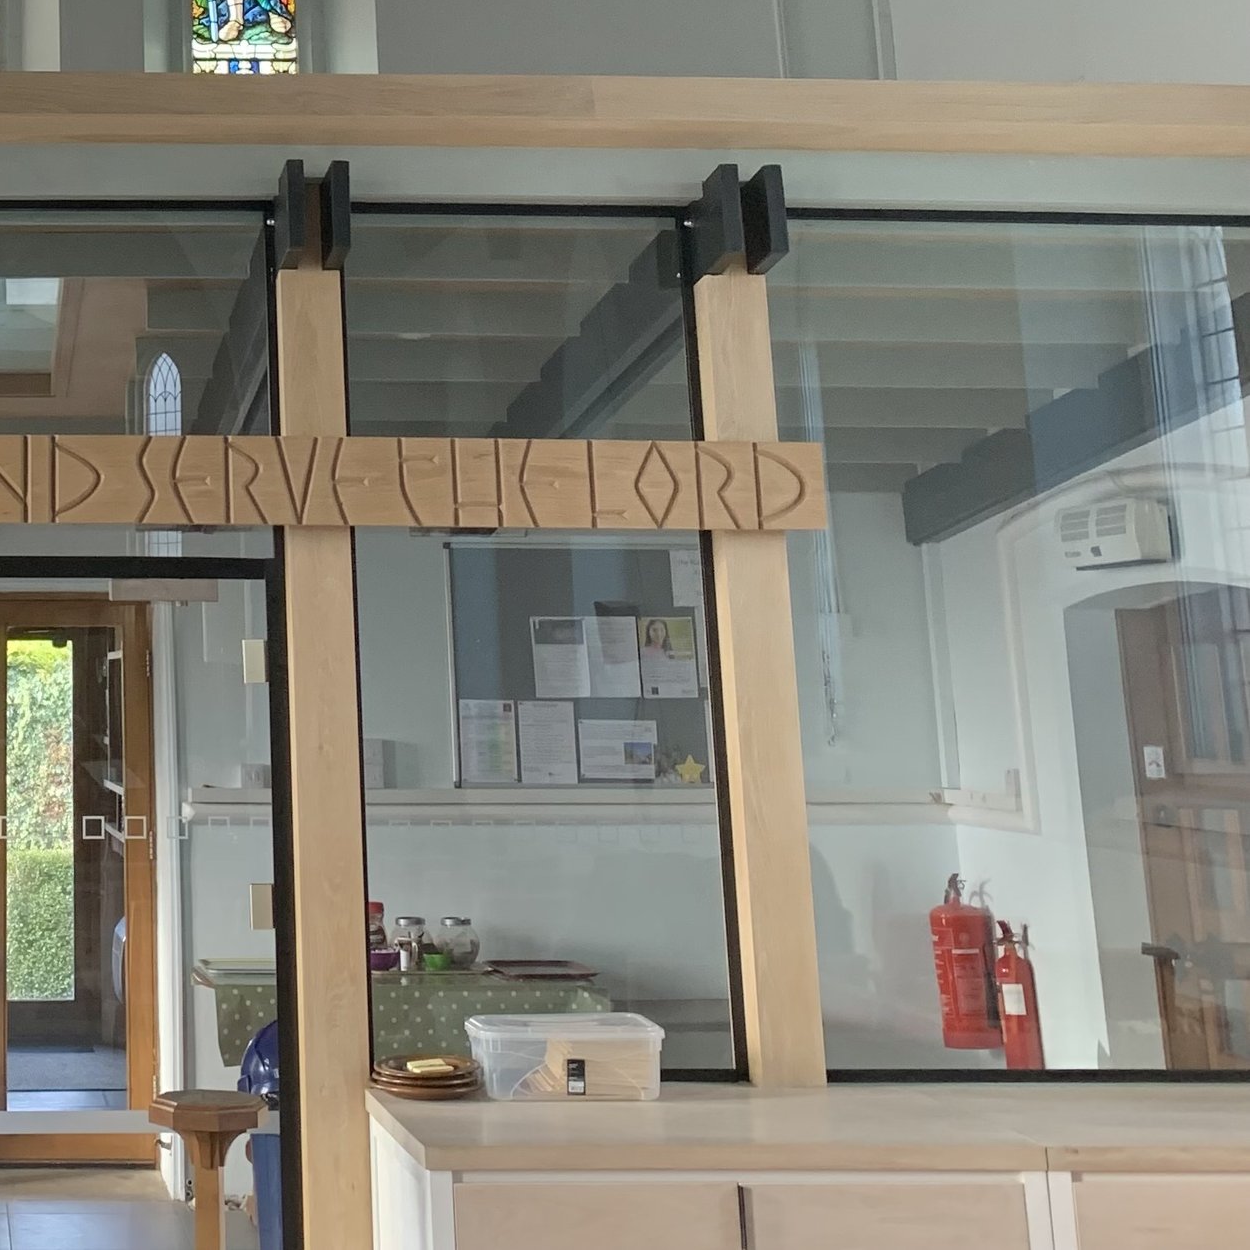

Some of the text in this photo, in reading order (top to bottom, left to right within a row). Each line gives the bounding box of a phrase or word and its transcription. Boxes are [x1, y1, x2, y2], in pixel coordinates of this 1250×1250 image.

[136, 435, 371, 526] SERVE
[396, 437, 561, 529] THE
[587, 439, 807, 531] LORD
